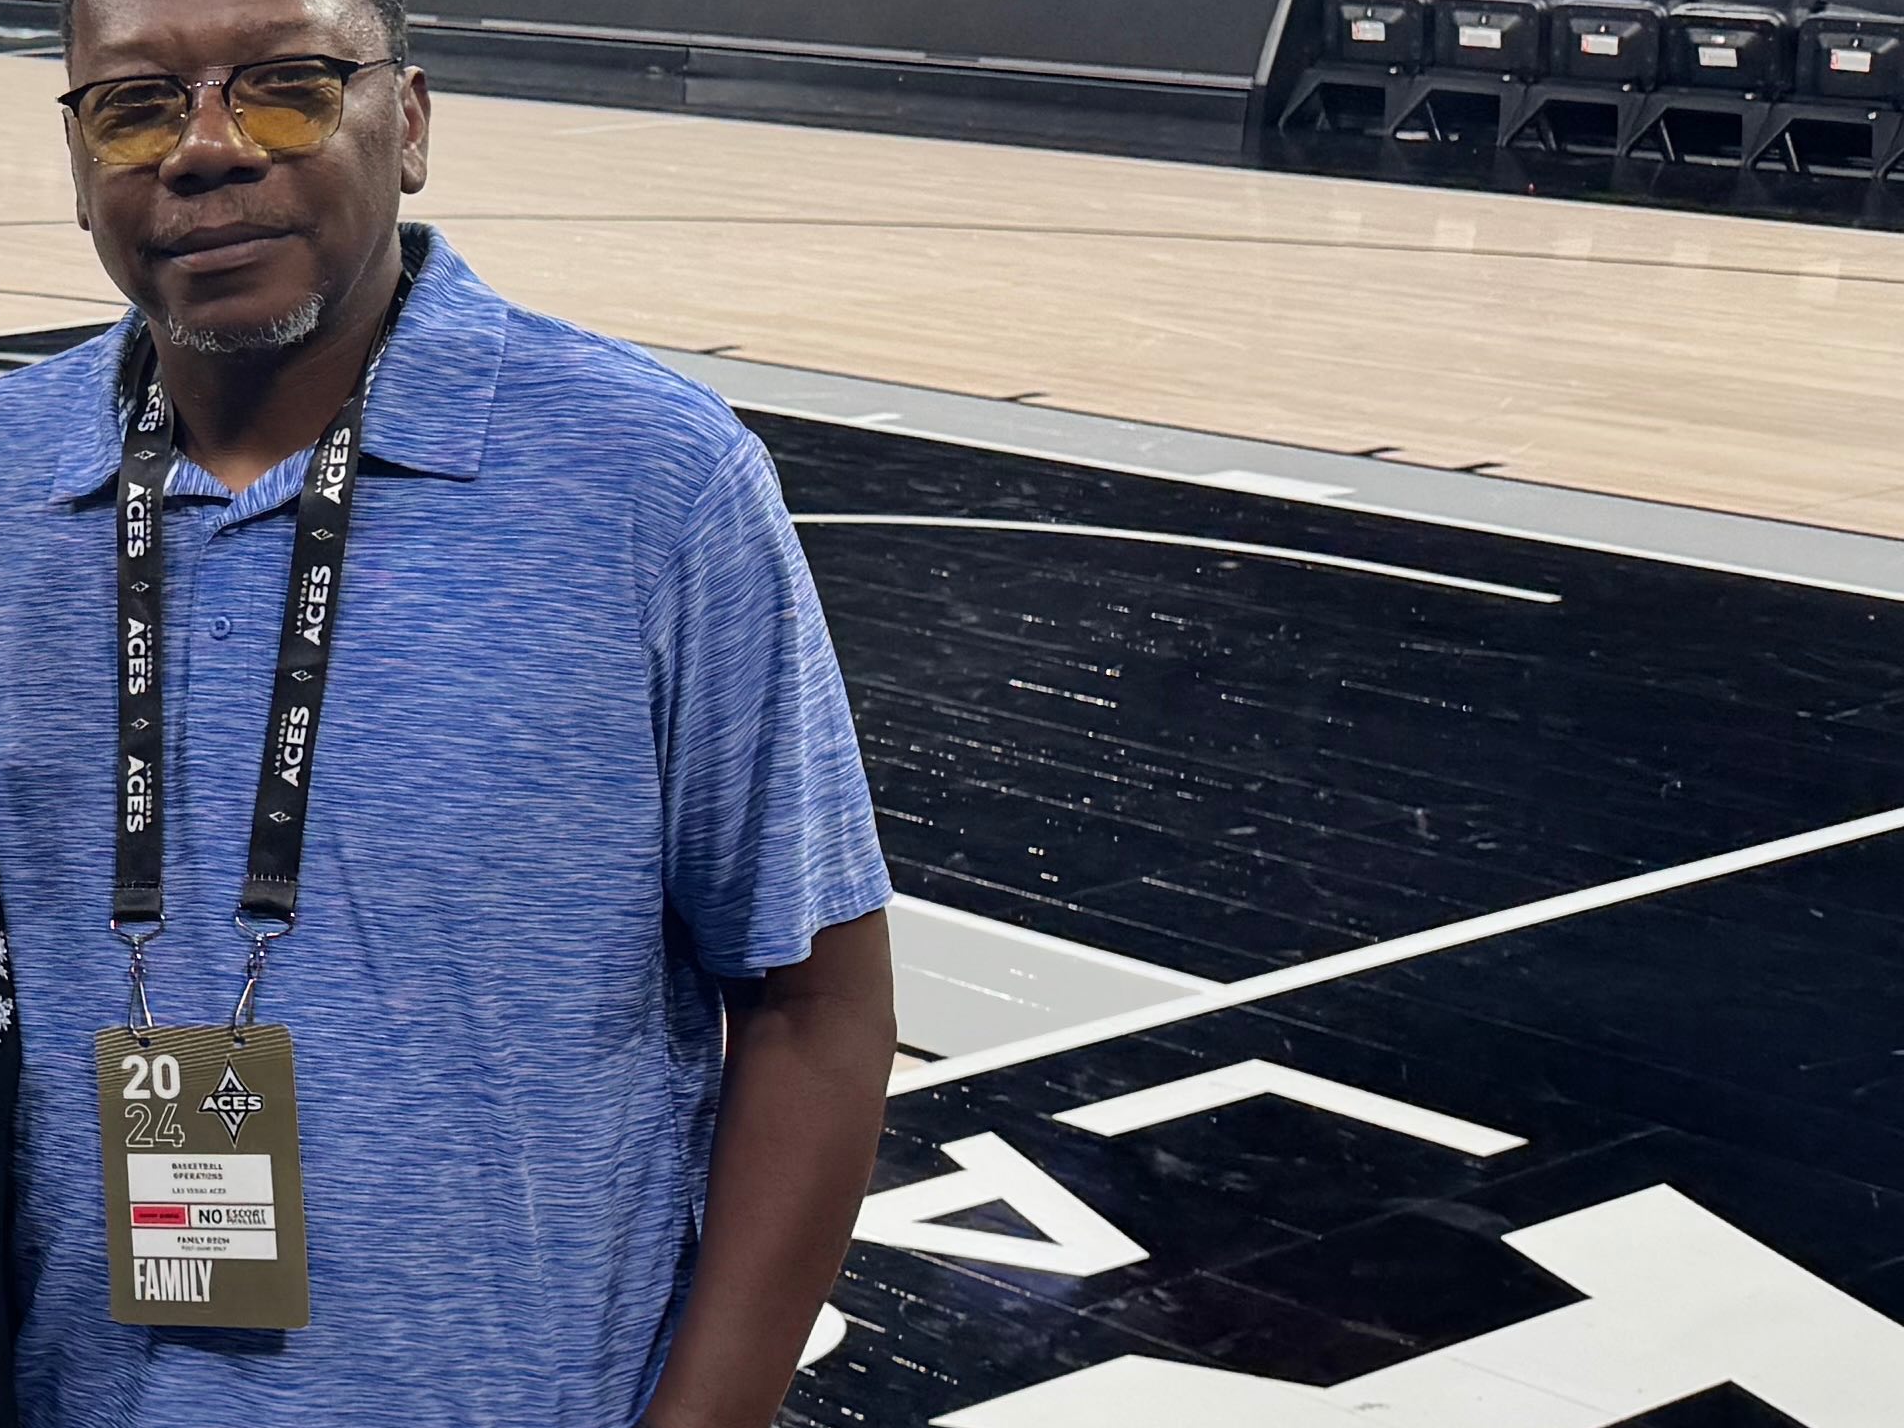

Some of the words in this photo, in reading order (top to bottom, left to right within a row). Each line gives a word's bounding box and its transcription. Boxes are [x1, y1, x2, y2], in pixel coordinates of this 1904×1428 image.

[137, 383, 162, 432] ACES
[322, 427, 352, 505] ACES
[126, 481, 146, 558] ACES
[297, 573, 309, 611] VEGAS
[302, 565, 332, 647] ACES
[127, 617, 146, 696] ACES
[277, 713, 288, 751] VEGAS
[281, 706, 310, 787] ACES
[126, 754, 145, 834] ACES
[122, 1054, 182, 1100] 20
[125, 1102, 186, 1148] 24
[200, 1095, 264, 1112] ACES
[171, 1162, 223, 1170] BASKETBALL
[198, 1209, 222, 1224] NO
[134, 1259, 213, 1302] FAMILY
